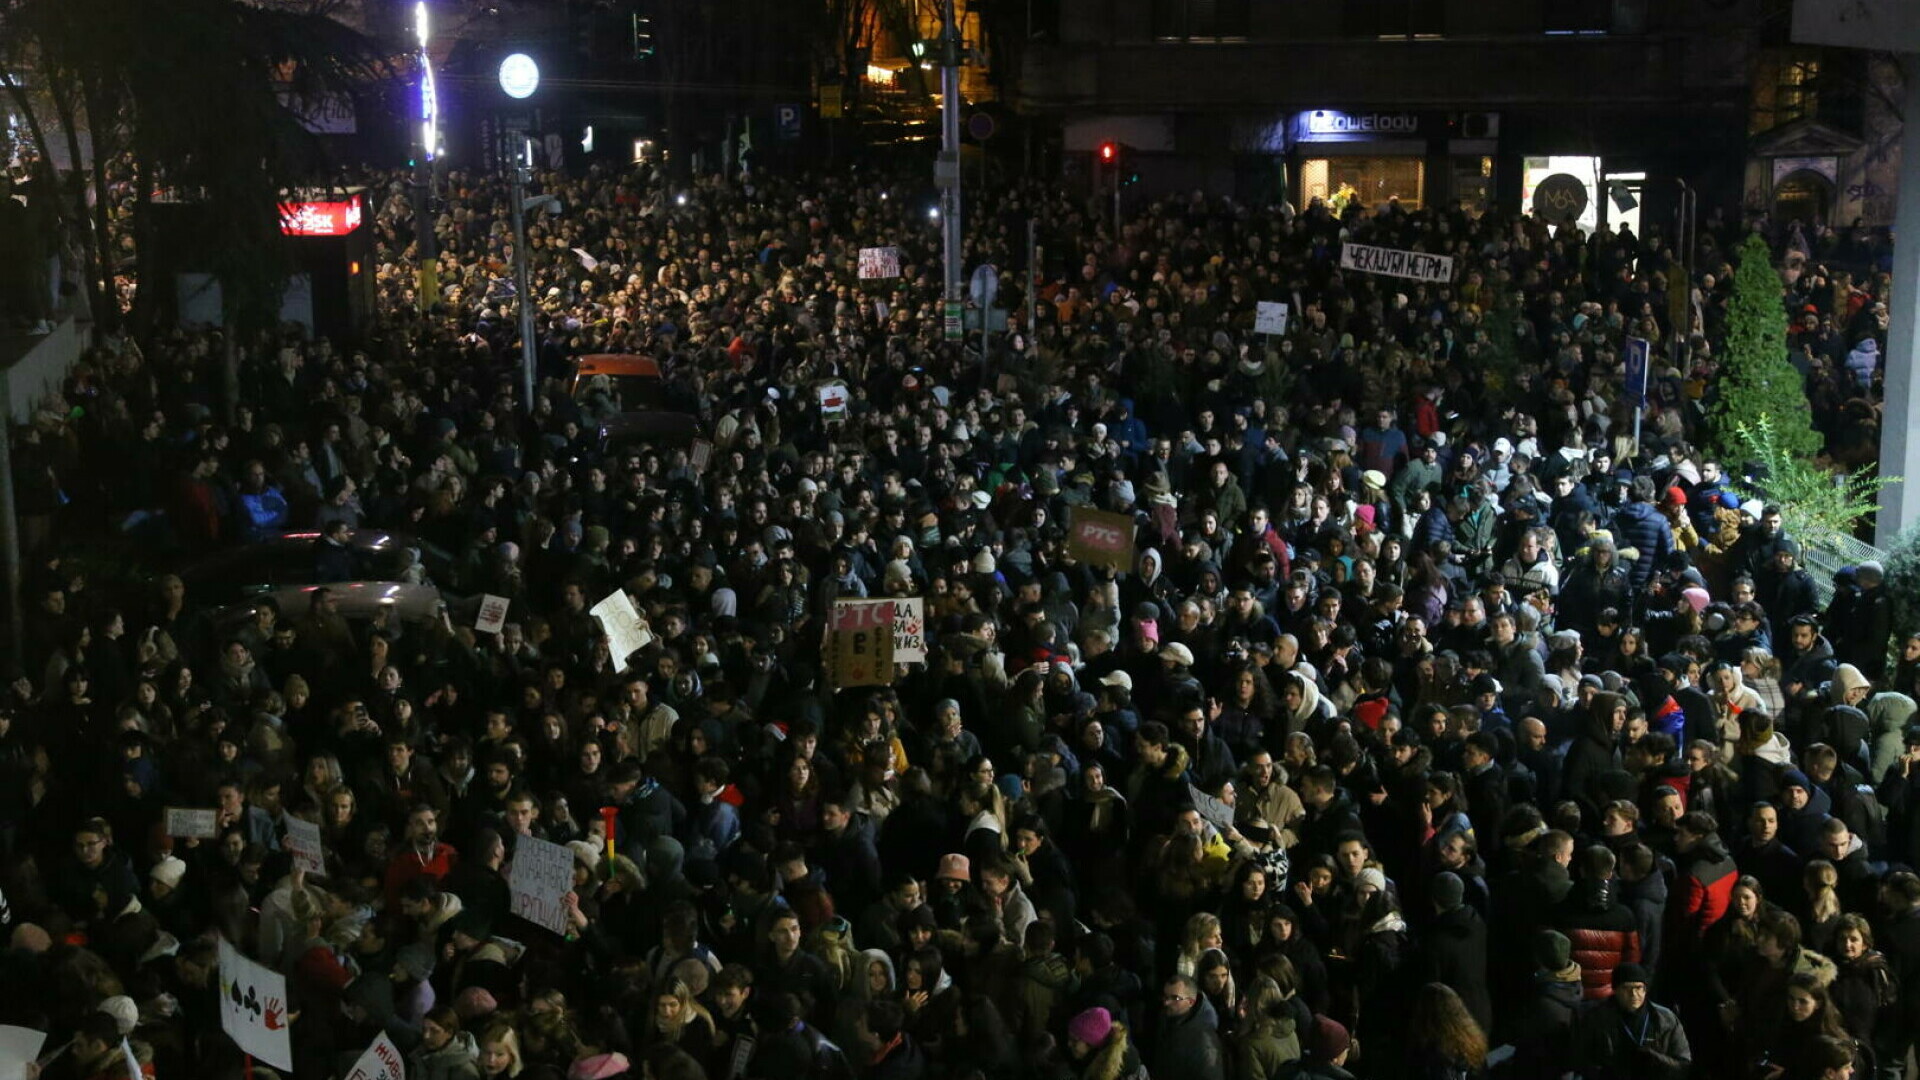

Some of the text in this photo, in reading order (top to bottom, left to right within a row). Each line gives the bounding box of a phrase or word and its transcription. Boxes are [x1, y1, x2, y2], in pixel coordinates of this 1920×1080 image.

[780, 108, 795, 126] P
[1082, 525, 1120, 545] РТС
[833, 603, 885, 630] РТС
